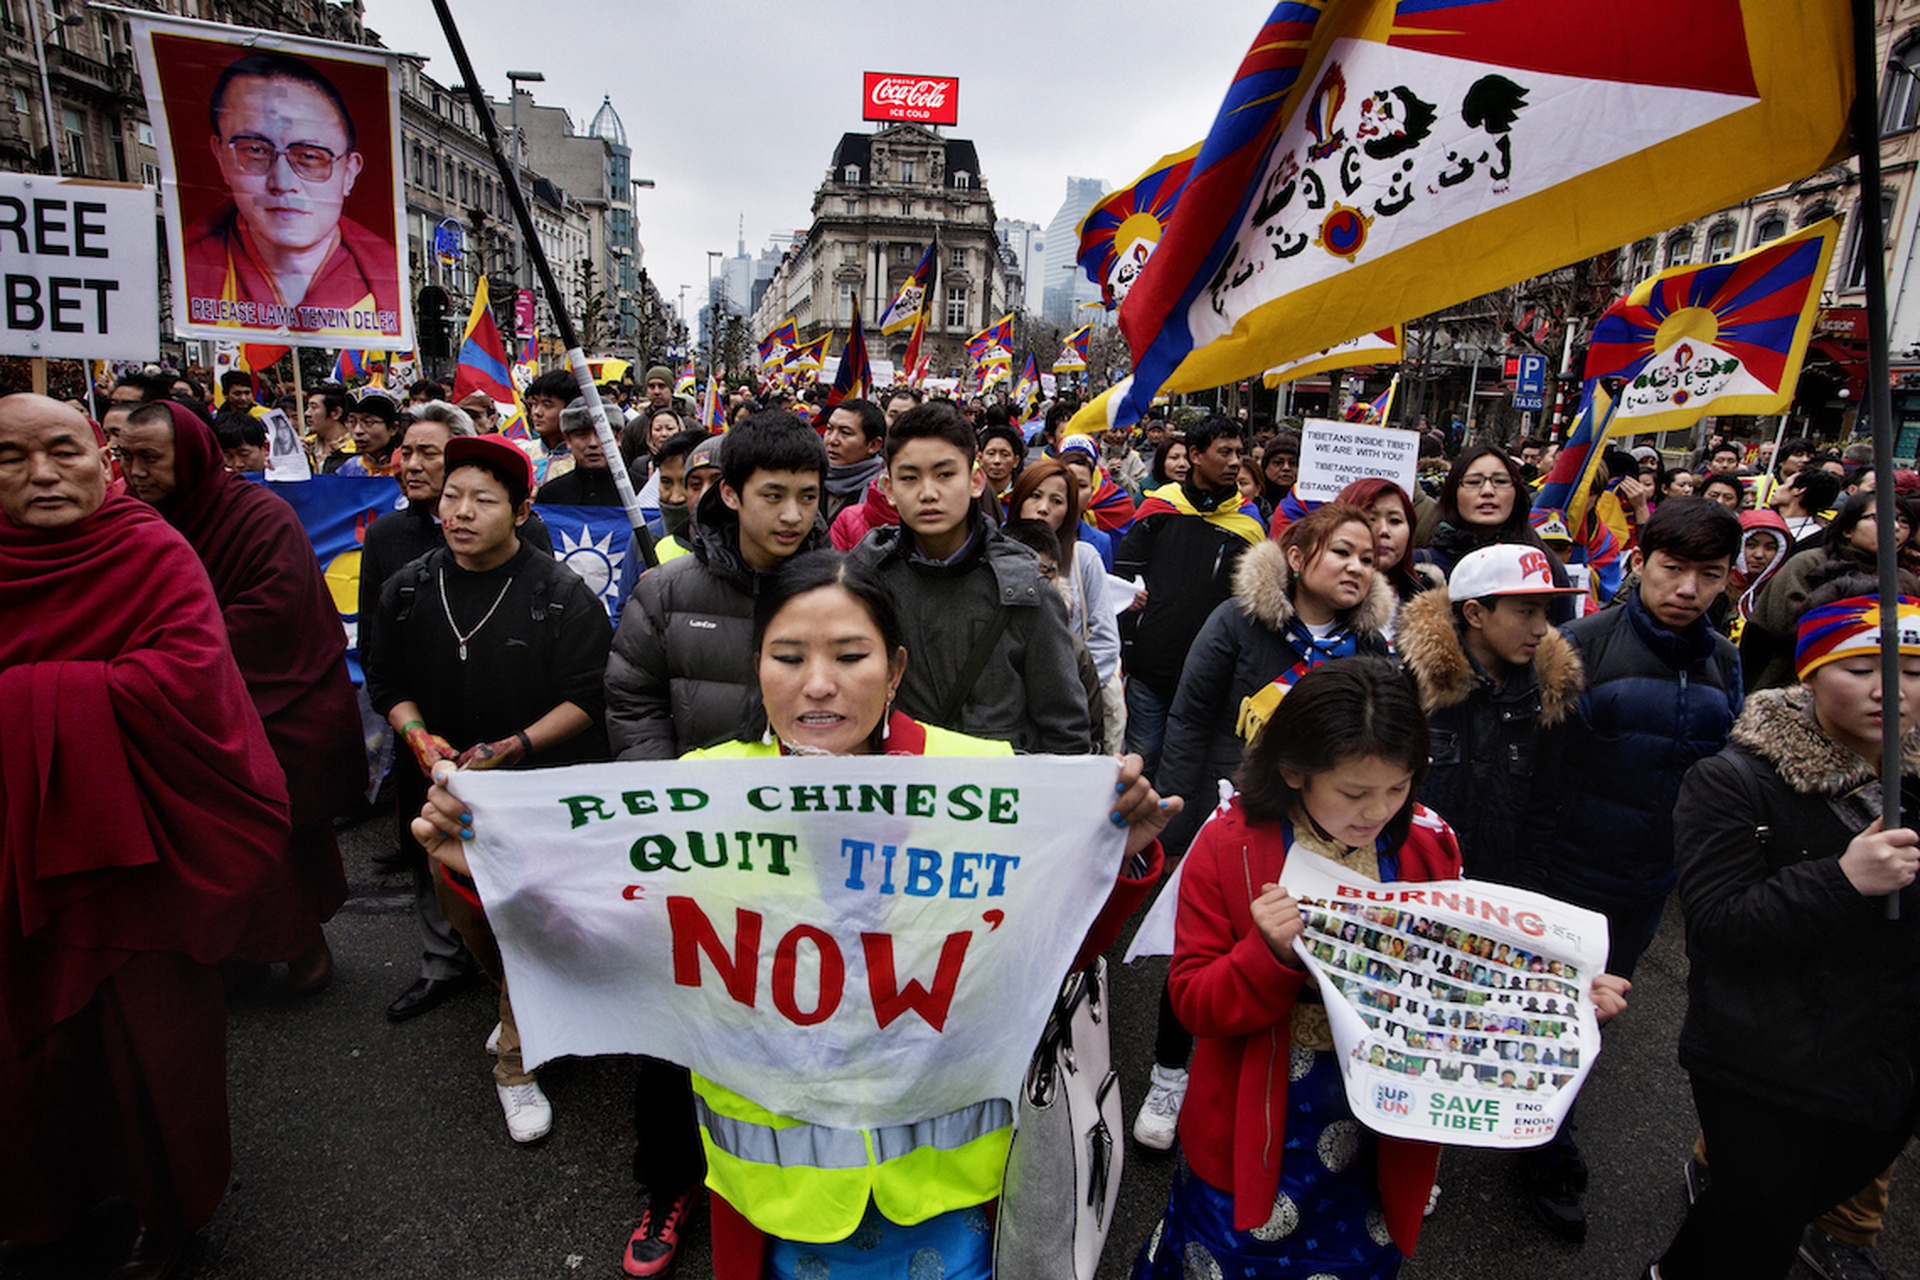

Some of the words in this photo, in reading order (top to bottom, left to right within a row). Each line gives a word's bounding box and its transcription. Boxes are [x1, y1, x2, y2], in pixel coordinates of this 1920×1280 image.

[872, 78, 950, 108] Coca-Cola
[906, 110, 930, 118] COLD
[0, 196, 109, 258] REE
[5, 274, 119, 334] BET
[192, 298, 256, 323] RELEASE
[259, 305, 299, 327] LAMA
[300, 308, 350, 329] TENZIN
[353, 311, 398, 331] DELEK
[1524, 358, 1540, 379] P
[1515, 397, 1542, 408] TAXIS
[1307, 431, 1353, 444] TIBETANS
[1354, 437, 1384, 447] INSIDE
[1386, 439, 1414, 451] TIBET!
[1315, 443, 1330, 453] WE
[1332, 445, 1352, 455] ARE
[1356, 448, 1380, 458] WITH
[1382, 451, 1404, 461] YOU!
[1315, 462, 1363, 474] TIBETANOS
[1364, 468, 1400, 479] DENTRO
[1334, 474, 1350, 483] DEL
[1300, 481, 1342, 493] ESTAMOS
[558, 787, 709, 829] RED
[747, 784, 1020, 824] CHINESE
[629, 830, 798, 876] QUIT
[840, 838, 1020, 898] TIBET
[1337, 885, 1545, 937] BURNING
[1384, 1086, 1408, 1102] UP
[1383, 1099, 1409, 1116] UN
[1430, 1092, 1500, 1117] SAVE
[1516, 1102, 1543, 1112] ENO
[1428, 1111, 1500, 1132] TIBET
[1513, 1125, 1554, 1135] CHIN
[1514, 1117, 1554, 1126] ENOU
